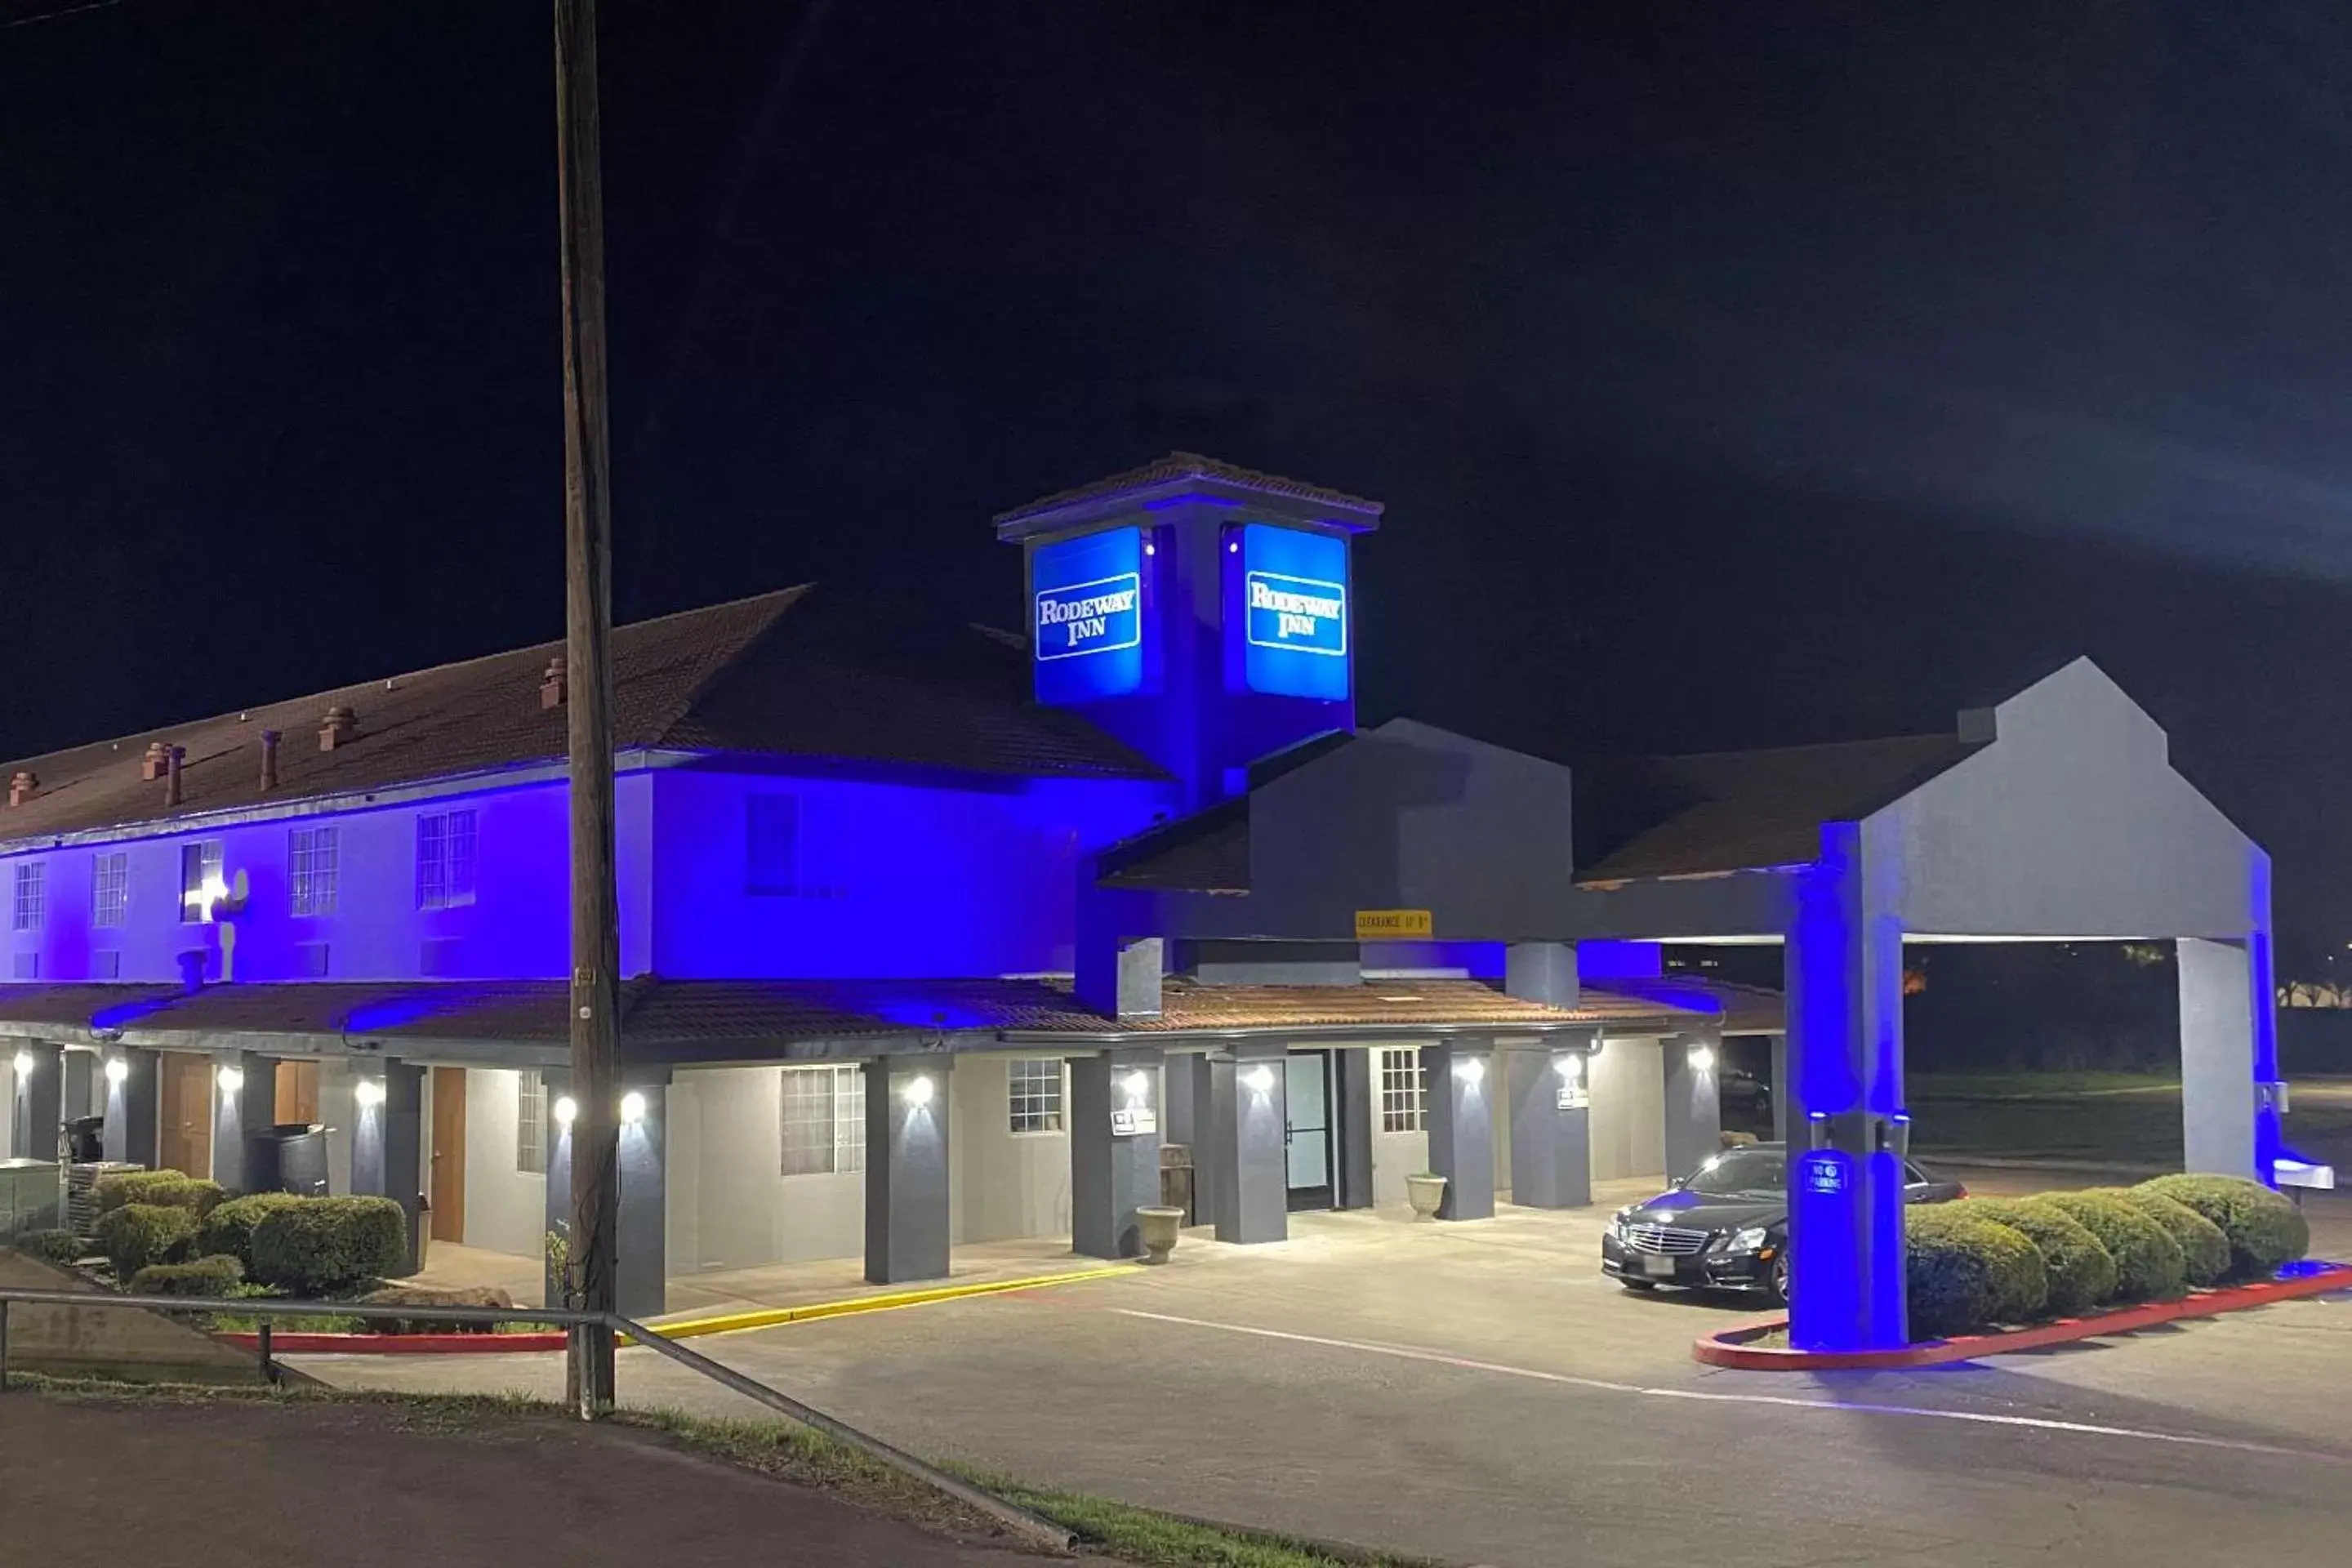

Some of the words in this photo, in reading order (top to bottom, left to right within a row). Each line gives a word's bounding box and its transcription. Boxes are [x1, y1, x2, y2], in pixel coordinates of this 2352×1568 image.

[1040, 590, 1136, 625] RODEWAY
[1250, 581, 1341, 620] RODEWAY
[1067, 616, 1107, 647] INN
[1277, 613, 1316, 638] INN
